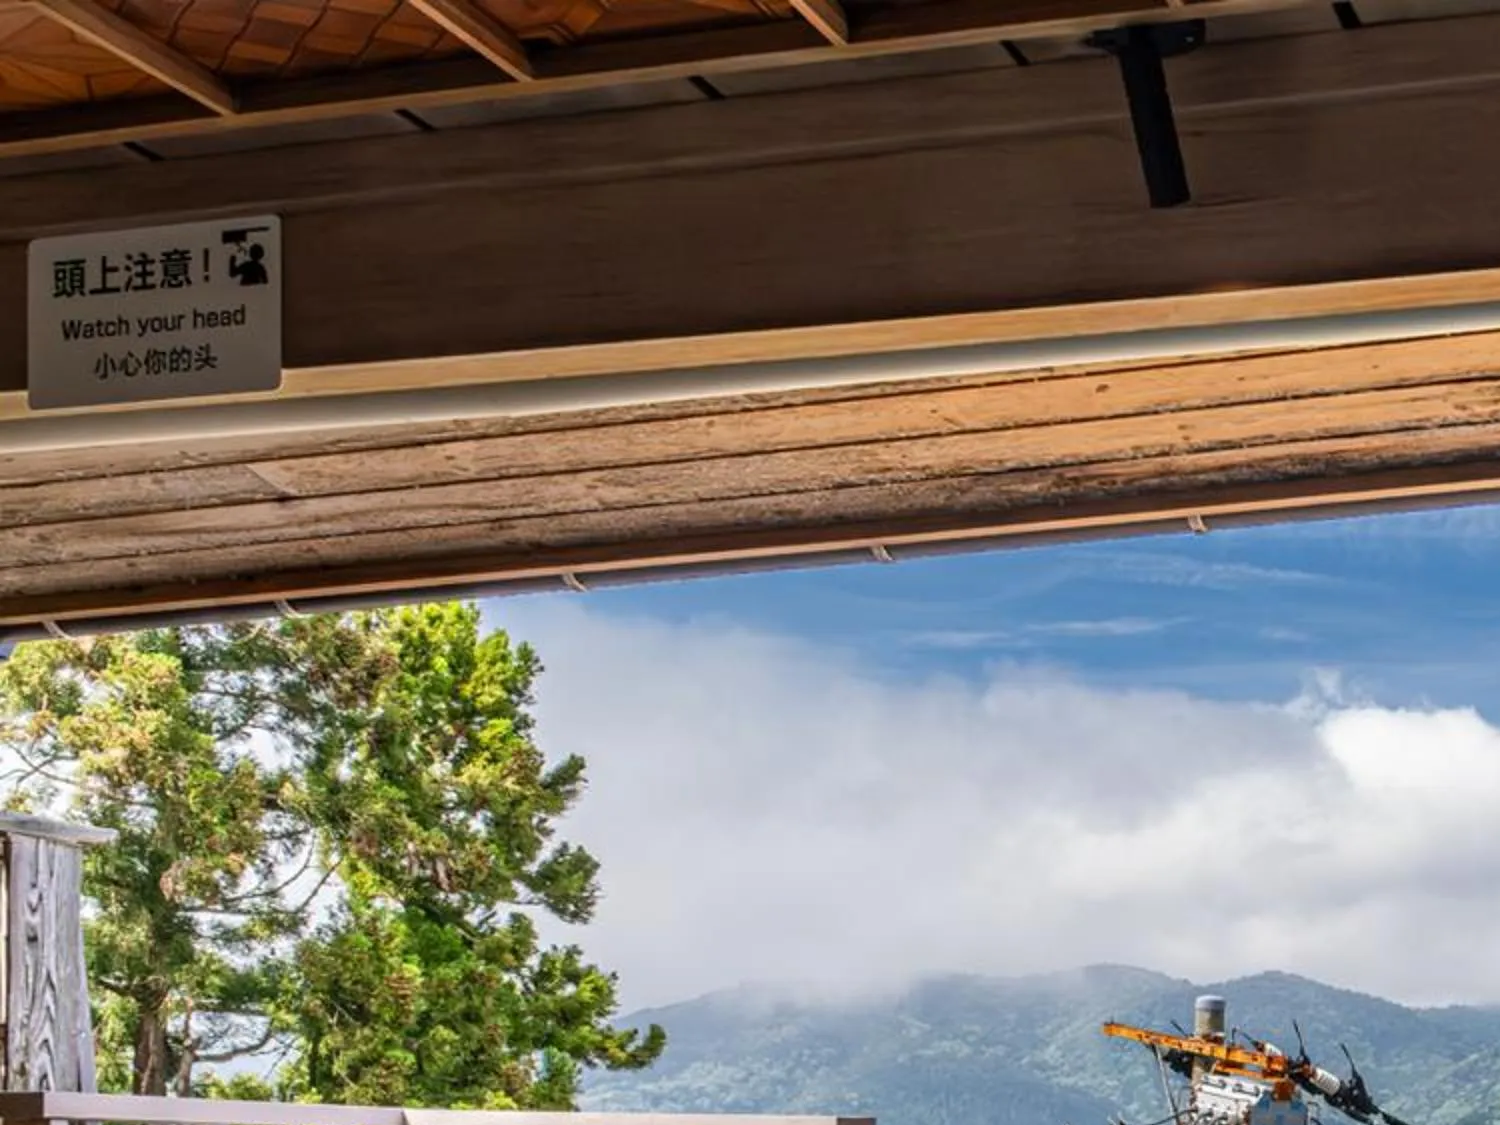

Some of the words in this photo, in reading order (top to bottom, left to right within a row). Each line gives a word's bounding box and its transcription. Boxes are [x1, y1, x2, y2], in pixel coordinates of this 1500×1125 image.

[52, 248, 211, 298] 頭上注意!
[62, 315, 130, 341] Watch
[138, 312, 186, 338] your
[193, 304, 246, 328] head
[94, 343, 218, 380] 小心你的头
